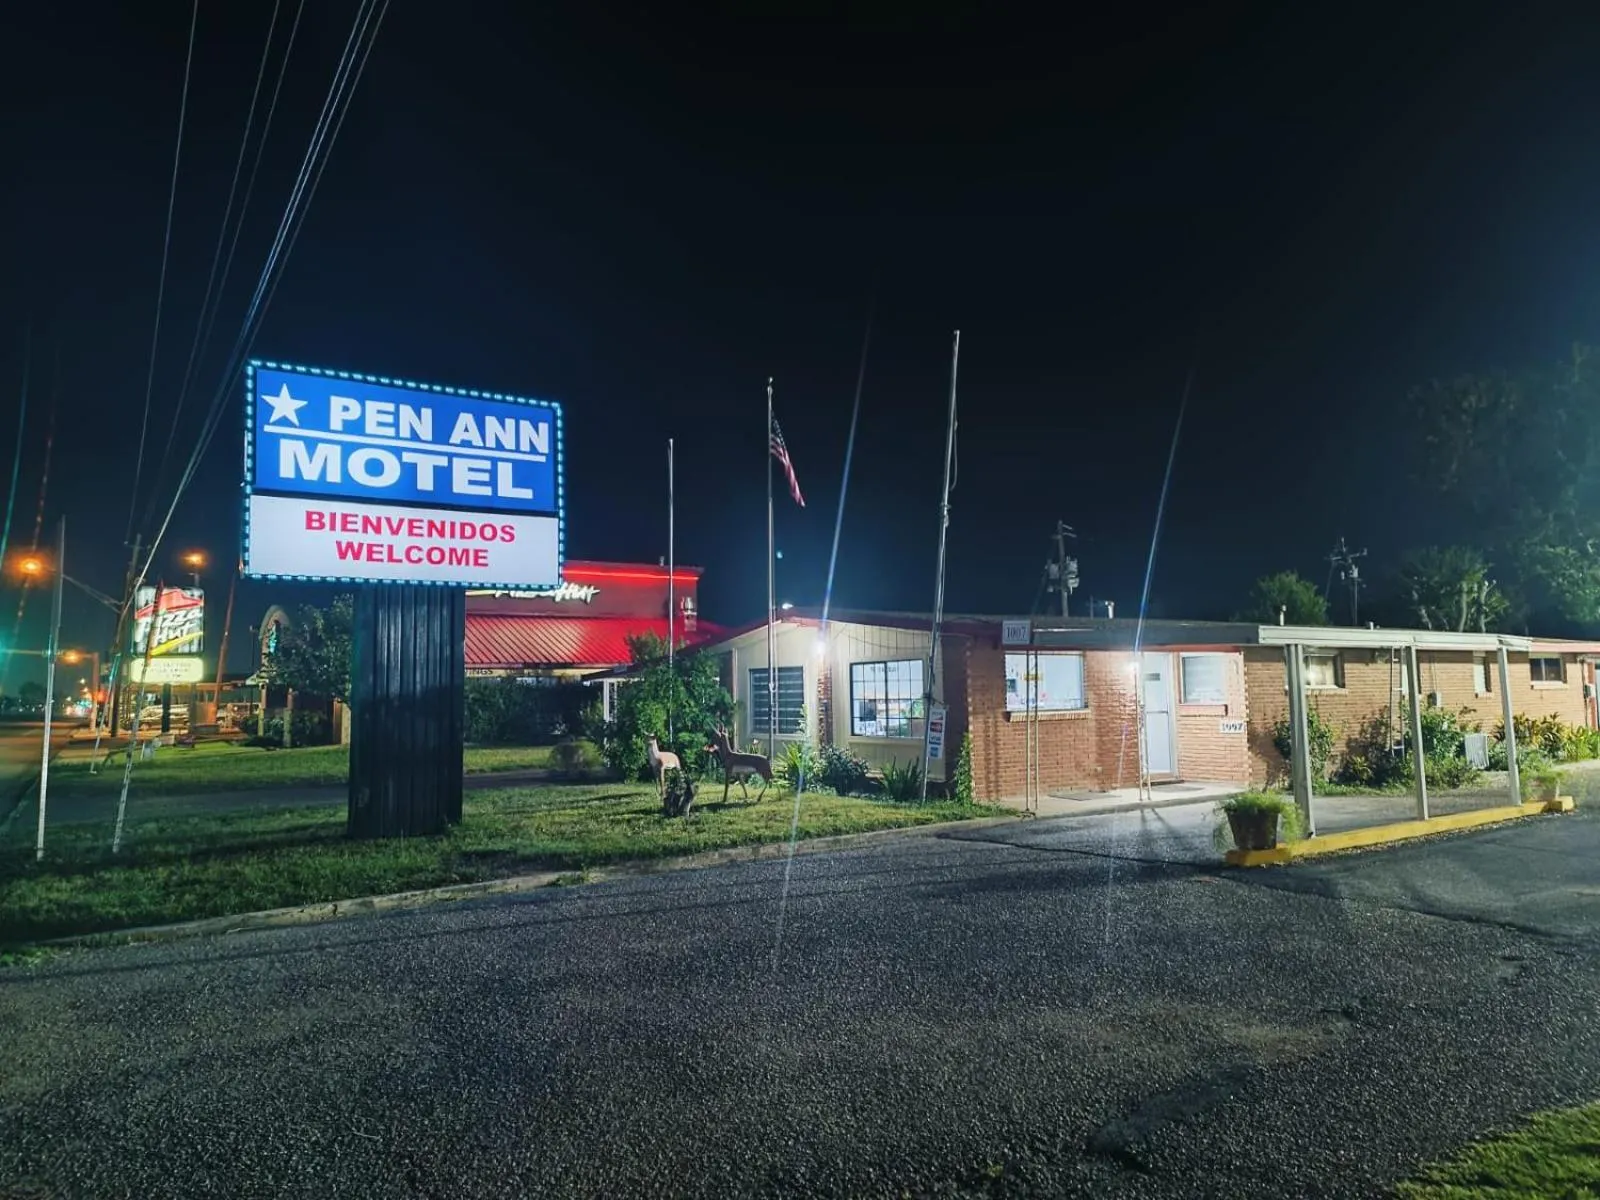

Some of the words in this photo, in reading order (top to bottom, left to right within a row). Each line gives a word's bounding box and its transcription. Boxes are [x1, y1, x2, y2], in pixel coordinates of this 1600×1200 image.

[329, 395, 433, 442] PEN
[449, 411, 549, 454] ANN
[278, 438, 534, 500] MOTEL
[304, 510, 516, 543] BIENVENIDOS
[335, 540, 489, 567] WELCOME
